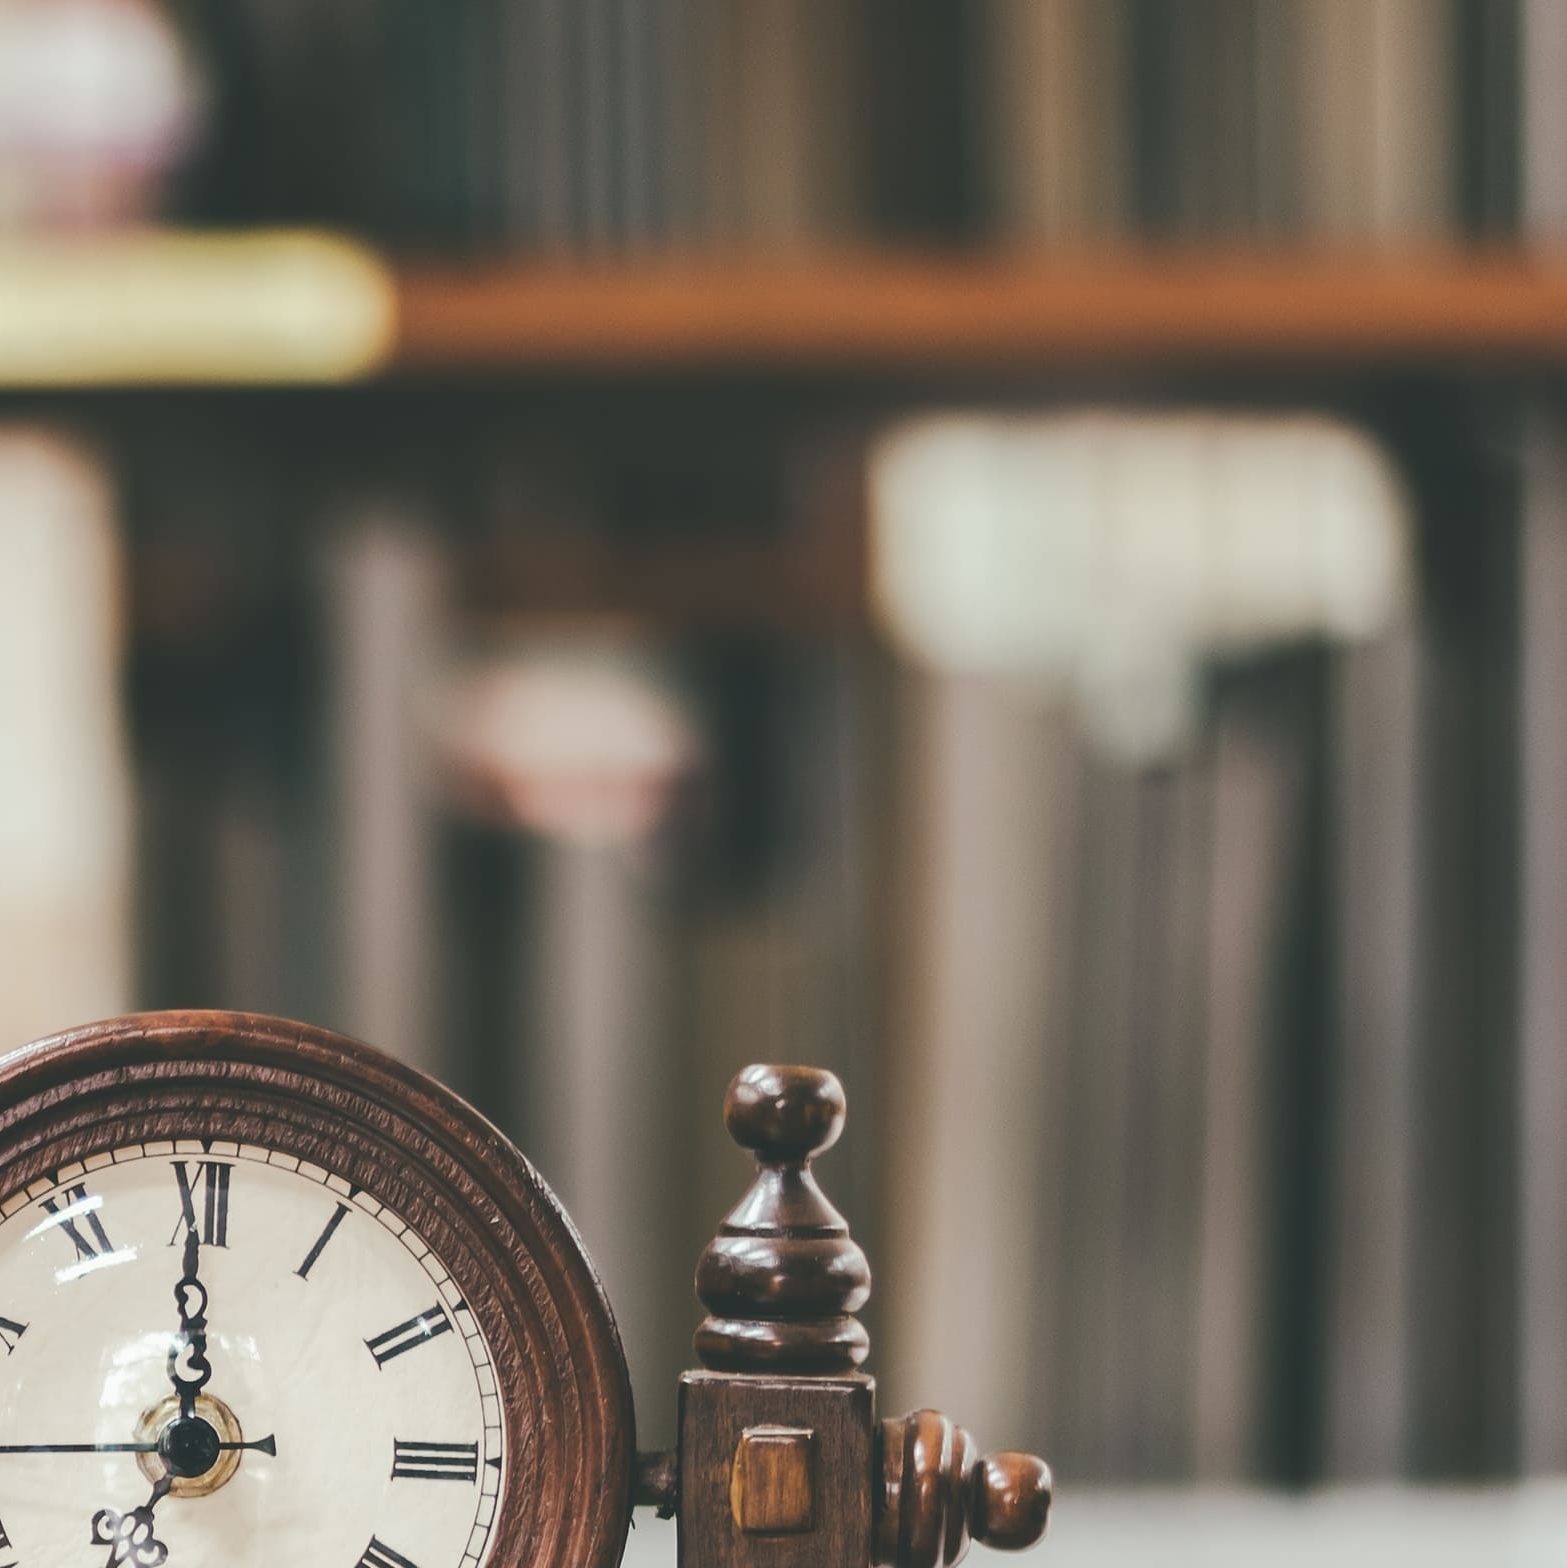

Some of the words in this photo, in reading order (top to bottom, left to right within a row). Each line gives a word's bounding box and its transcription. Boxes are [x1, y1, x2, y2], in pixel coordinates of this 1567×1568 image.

[38, 1181, 115, 1263] XI
[168, 1160, 236, 1249] XII
[294, 1201, 353, 1280] I
[364, 1300, 454, 1370] II
[391, 1438, 479, 1485] III
